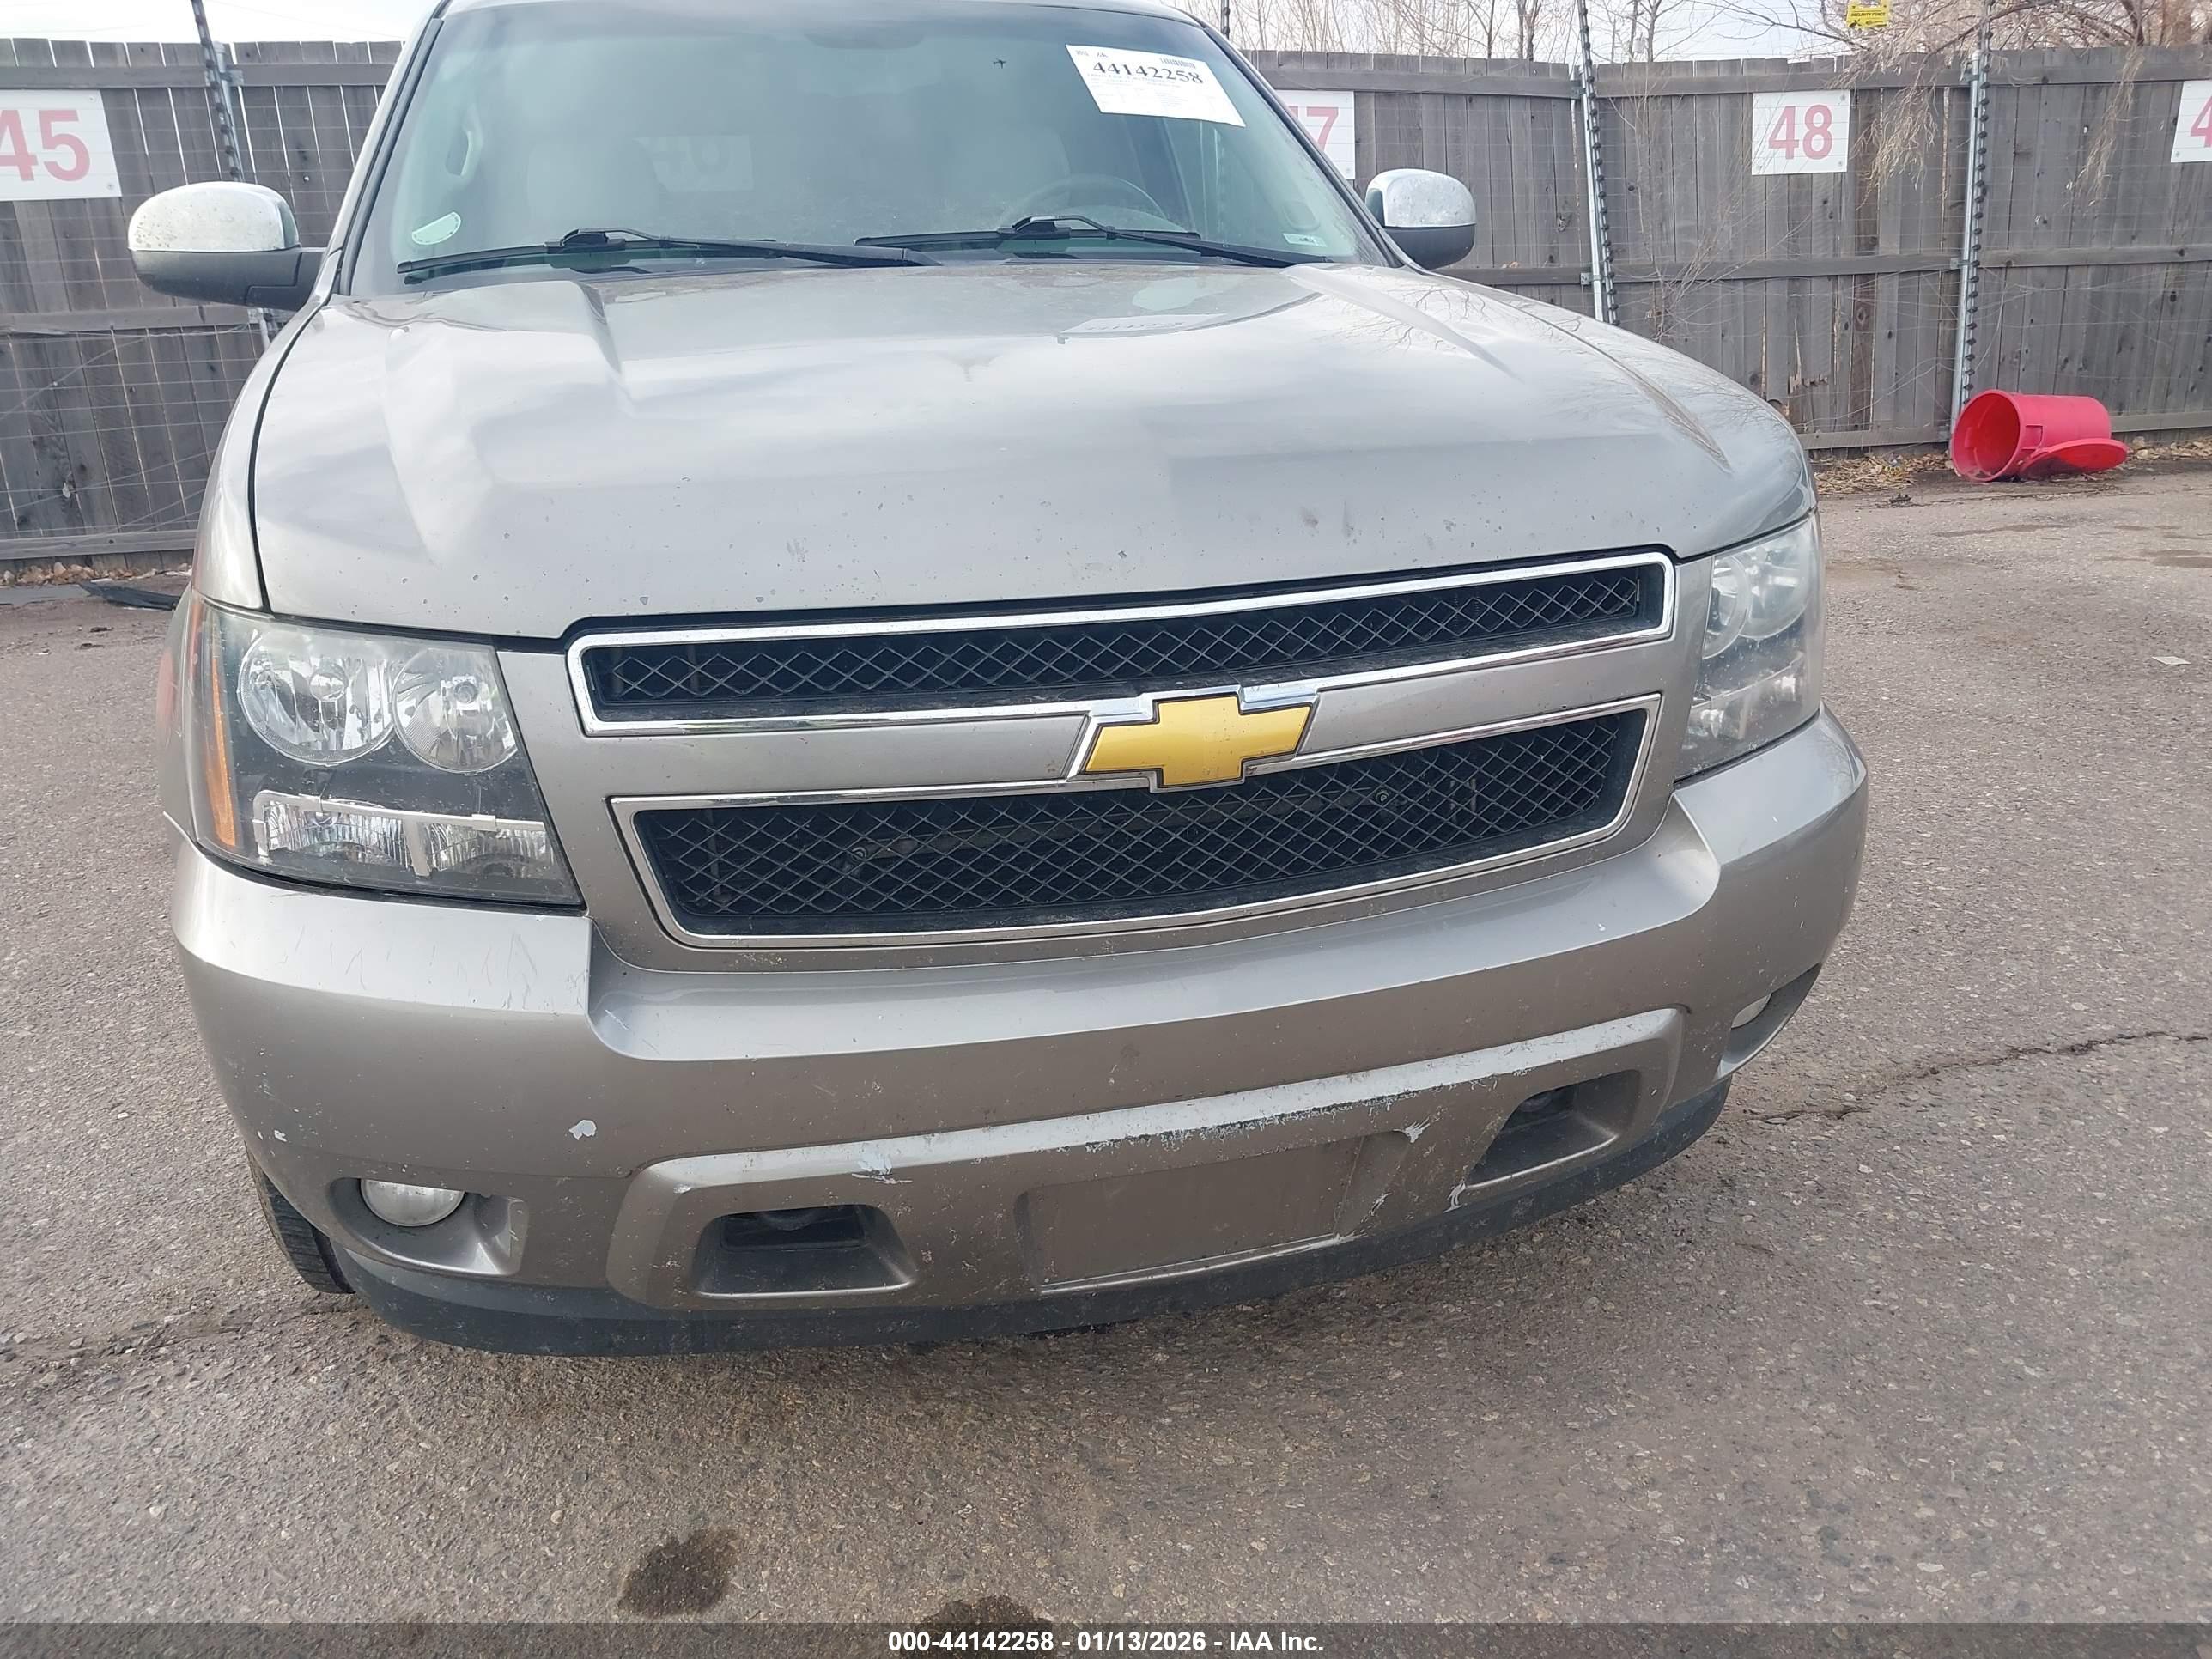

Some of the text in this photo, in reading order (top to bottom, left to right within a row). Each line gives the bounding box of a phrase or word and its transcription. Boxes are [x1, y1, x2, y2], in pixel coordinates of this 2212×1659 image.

[1092, 61, 1204, 84] 44142258
[0, 109, 90, 181] 45
[1288, 106, 1339, 152] 7
[1769, 104, 1833, 161] 48
